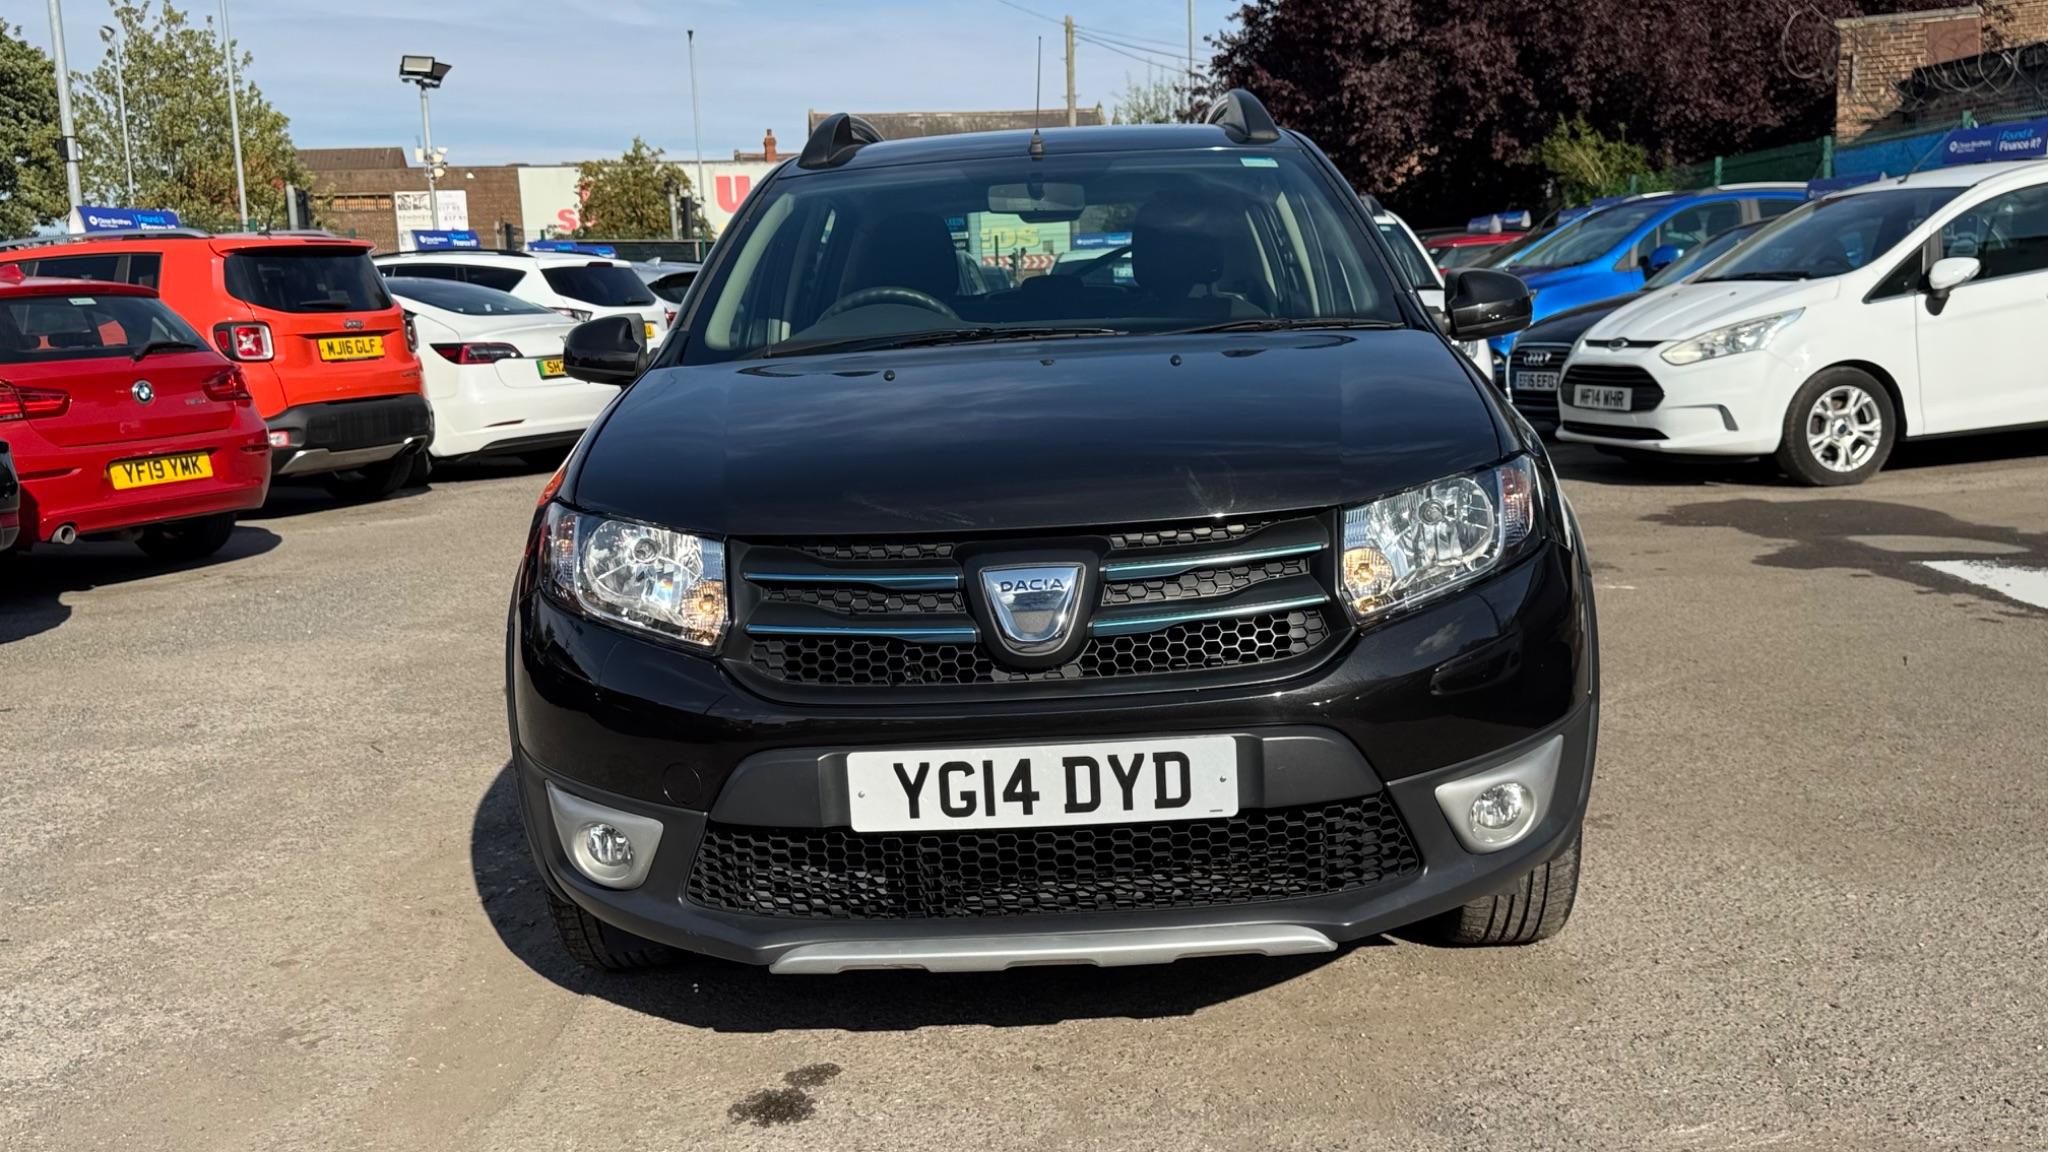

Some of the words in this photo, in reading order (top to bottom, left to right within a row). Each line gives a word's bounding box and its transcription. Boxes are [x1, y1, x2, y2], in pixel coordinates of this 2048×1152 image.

[327, 340, 353, 355] MJ16
[356, 338, 376, 354] GLF
[1602, 389, 1623, 407] WHR
[122, 462, 164, 484] YF19
[169, 455, 203, 476] YMK
[1000, 578, 1065, 592] DACIA
[892, 758, 1040, 819] YG14
[1062, 750, 1192, 814] DYD
